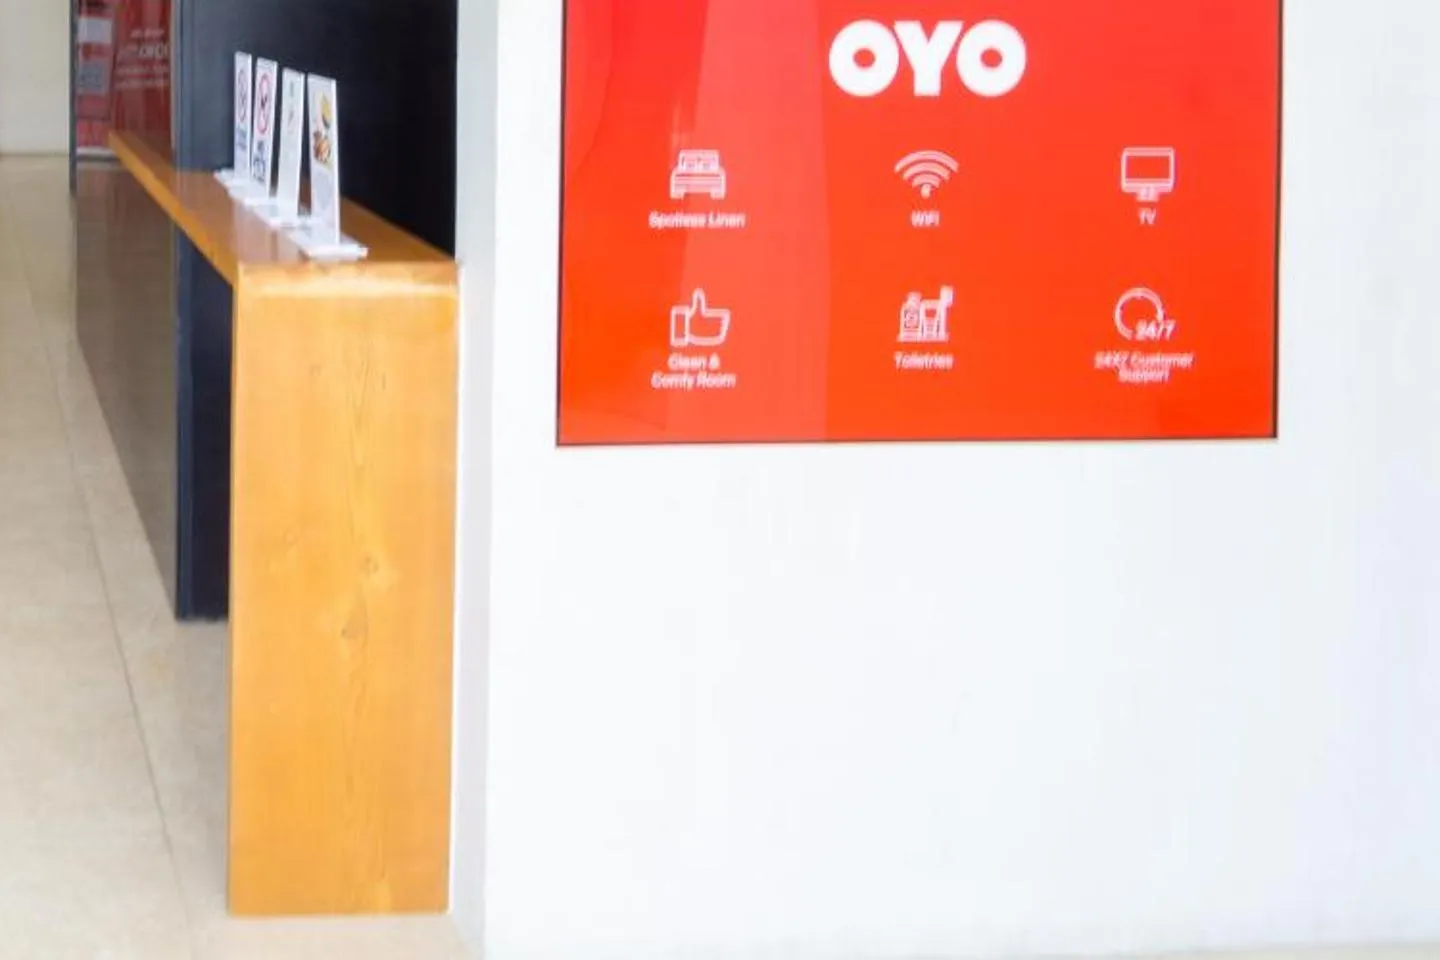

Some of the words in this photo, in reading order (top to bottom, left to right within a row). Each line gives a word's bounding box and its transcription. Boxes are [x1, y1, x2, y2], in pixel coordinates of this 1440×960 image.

[828, 19, 1027, 98] OYO
[708, 211, 747, 229] Linen
[1138, 207, 1157, 226] TV
[1135, 319, 1177, 341] 24/7
[667, 352, 707, 371] Clean
[708, 352, 721, 371] &
[894, 351, 954, 370] Toiletries
[1130, 350, 1195, 369] Customer
[651, 370, 695, 392] Comfy
[696, 371, 737, 389] Room
[1118, 366, 1171, 385] Support
